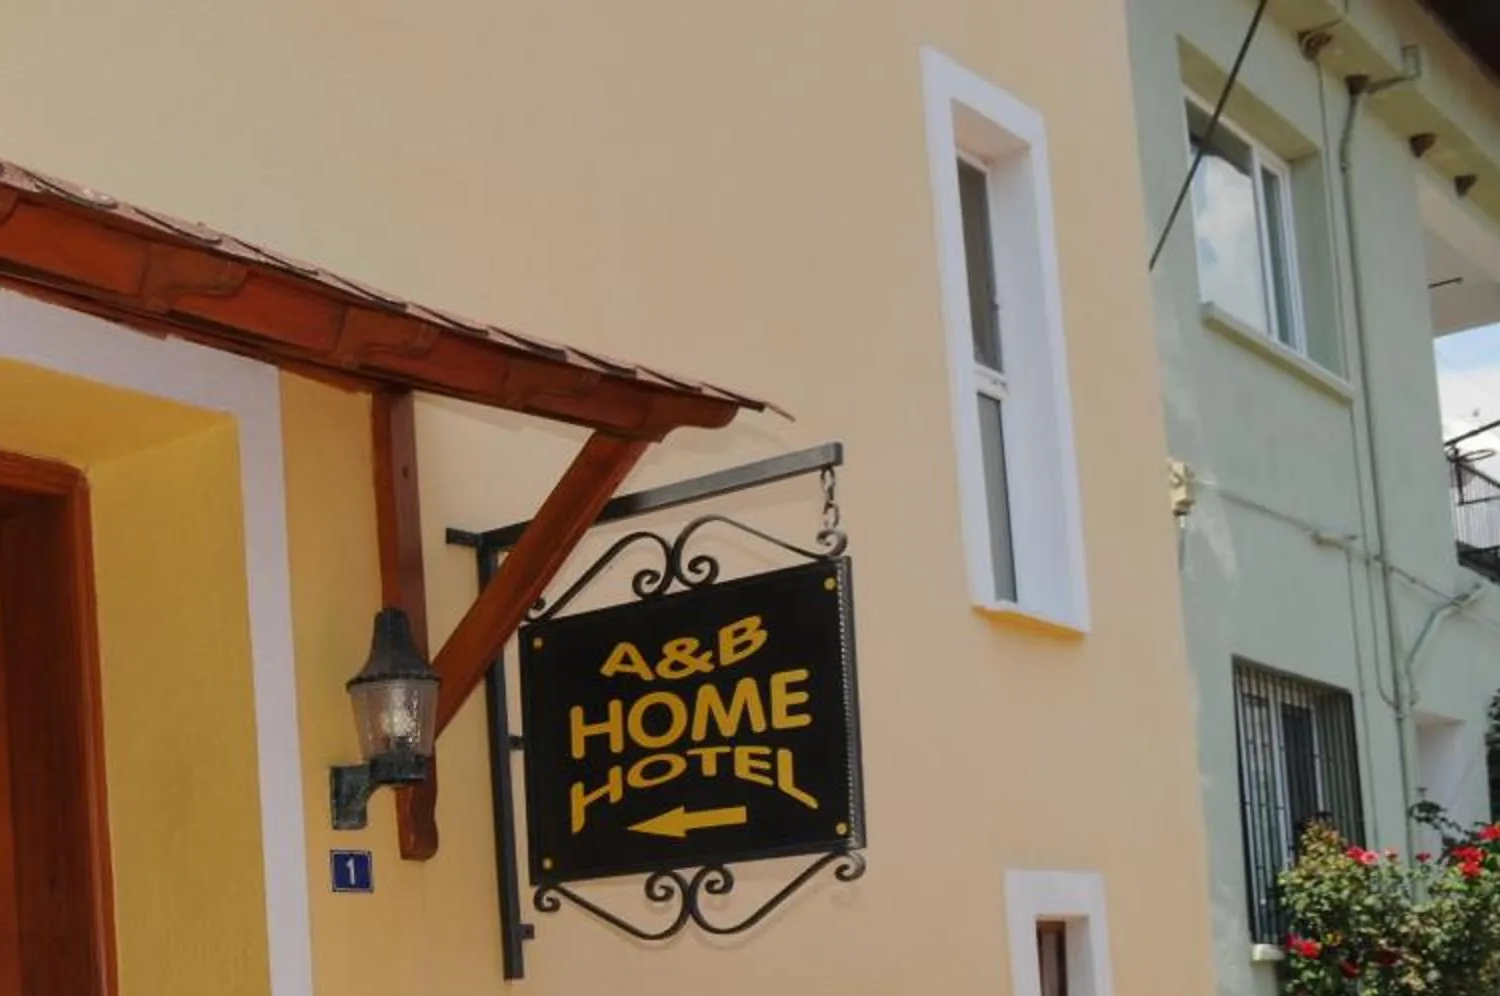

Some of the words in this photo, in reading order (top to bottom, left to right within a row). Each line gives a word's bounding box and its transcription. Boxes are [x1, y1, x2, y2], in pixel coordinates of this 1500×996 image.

[601, 614, 768, 681] A&B
[570, 668, 812, 759] HOME
[570, 745, 818, 834] HOTEL
[346, 857, 356, 886] 1
